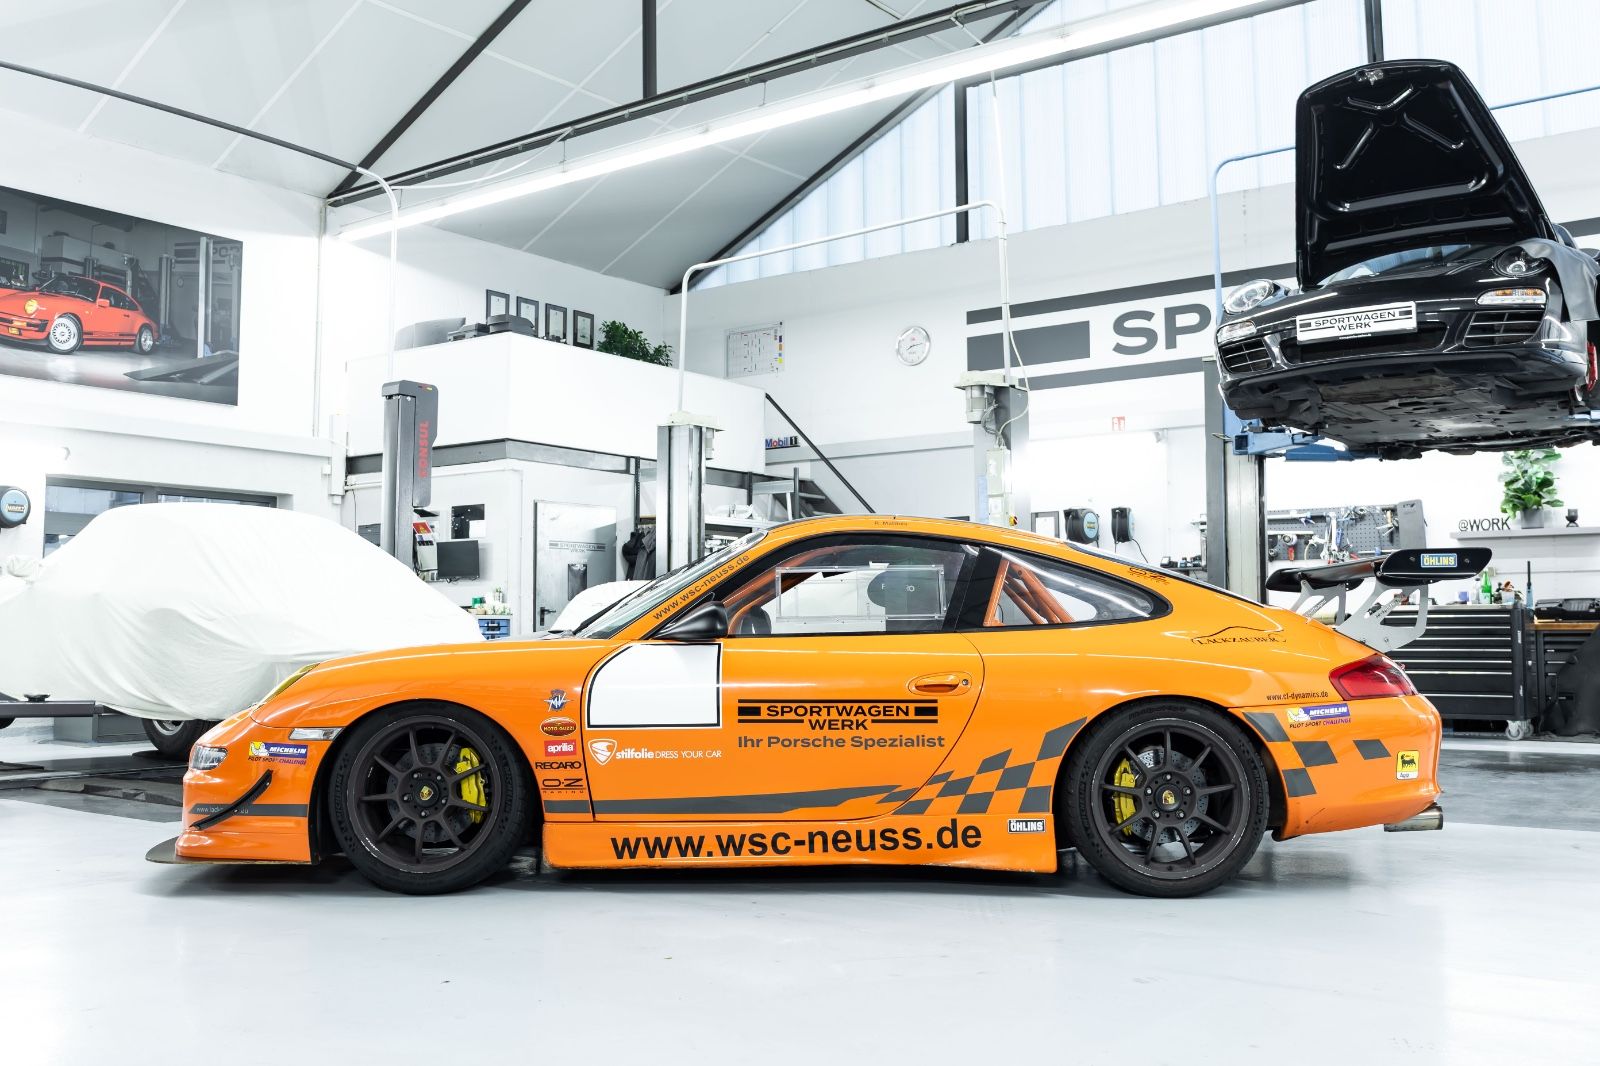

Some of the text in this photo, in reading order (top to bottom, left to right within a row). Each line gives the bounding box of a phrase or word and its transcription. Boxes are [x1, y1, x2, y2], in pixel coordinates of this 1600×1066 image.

[1314, 310, 1396, 327] SPORTWAGEN
[1337, 321, 1372, 332] WERK
[765, 436, 788, 448] Mobil
[1458, 516, 1511, 532] @WORK
[1423, 554, 1455, 566] ÖHLINS
[653, 555, 750, 620] www.wsc-neuss.de
[766, 705, 910, 717] SPORTWAGEN
[1309, 707, 1347, 715] MICHELIN
[808, 719, 869, 731] WERK
[1289, 721, 1305, 729] PILOT
[1305, 720, 1322, 728] SPORT
[547, 742, 573, 753] aprilia
[737, 735, 945, 750] Ihr Porsche Spezialist
[269, 746, 307, 754] MICHELIN
[616, 747, 722, 759] stilfolie DRESS YOUR CAR
[535, 761, 582, 769] RECARO
[1010, 820, 1044, 832] ÖHLINS
[611, 818, 982, 860] www.wsc-neuss.de
